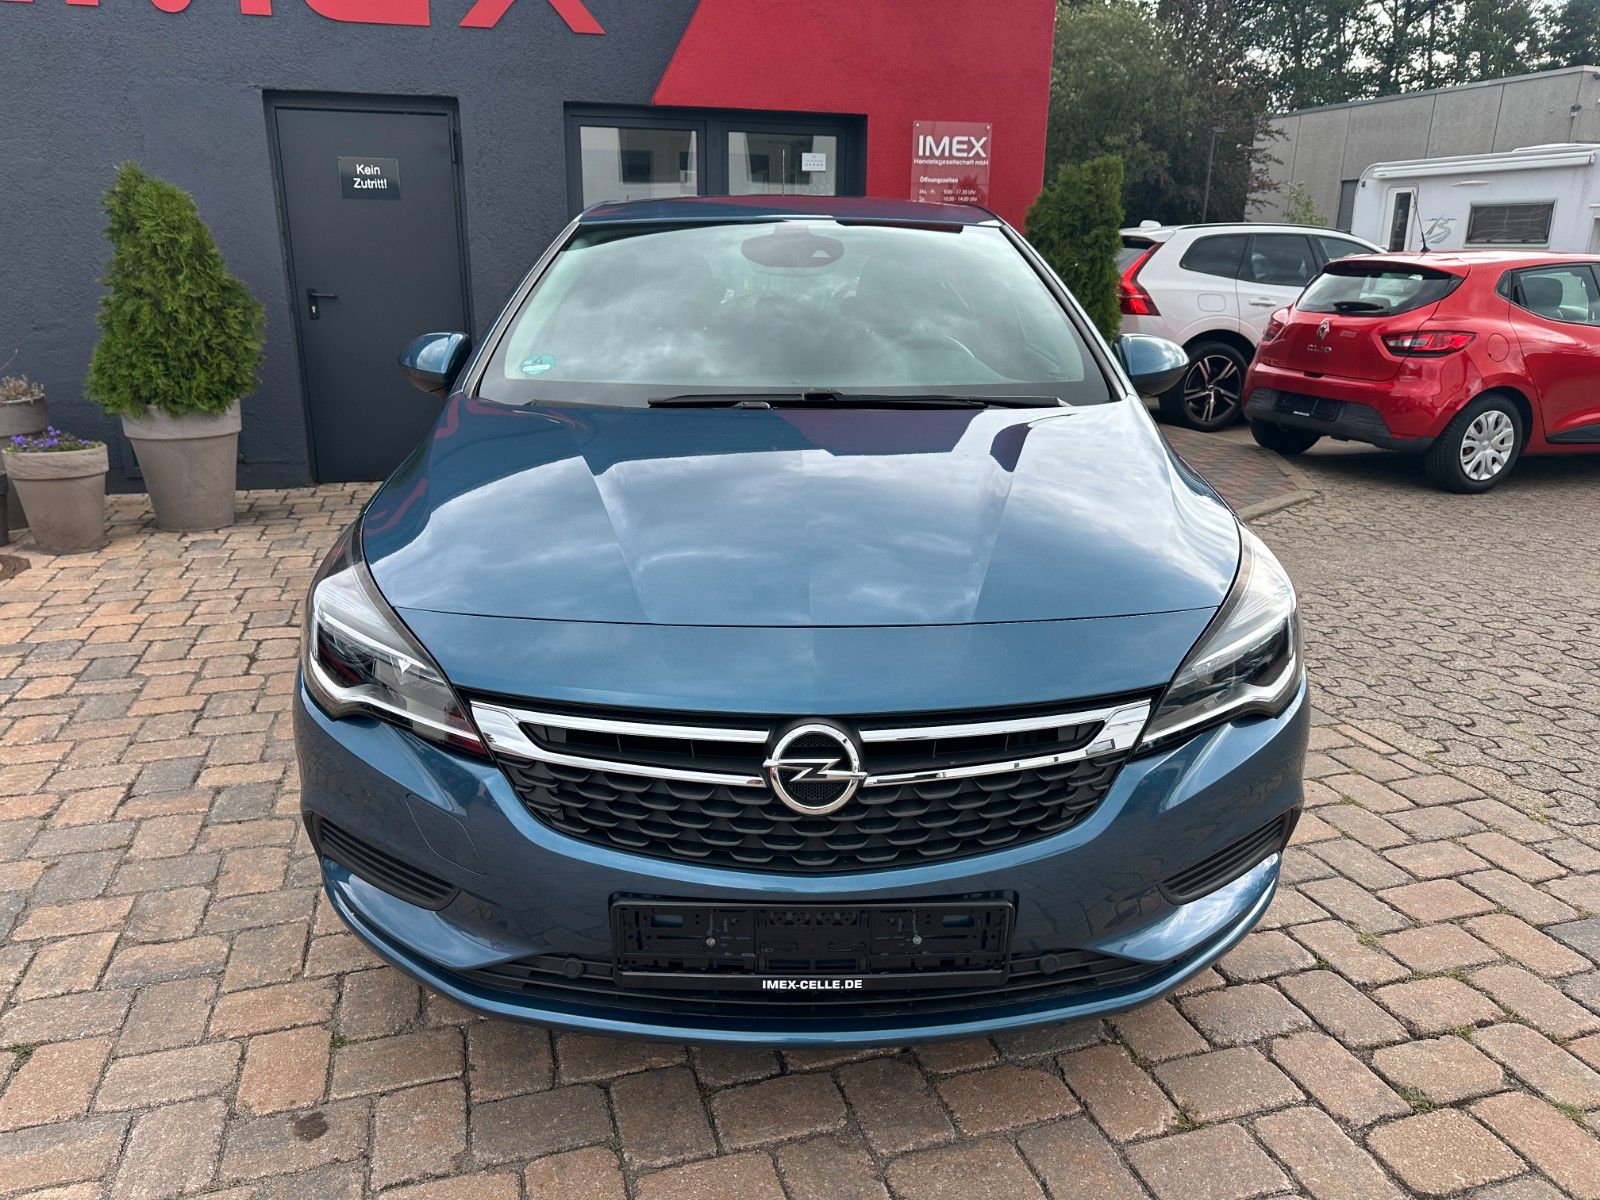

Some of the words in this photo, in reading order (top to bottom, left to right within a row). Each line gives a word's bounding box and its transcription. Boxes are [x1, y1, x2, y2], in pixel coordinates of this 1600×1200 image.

[918, 135, 987, 157] IMEX
[356, 164, 381, 175] Kein
[353, 178, 388, 189] Zutritt!
[762, 979, 863, 990] IMEX-CELLE.DE
